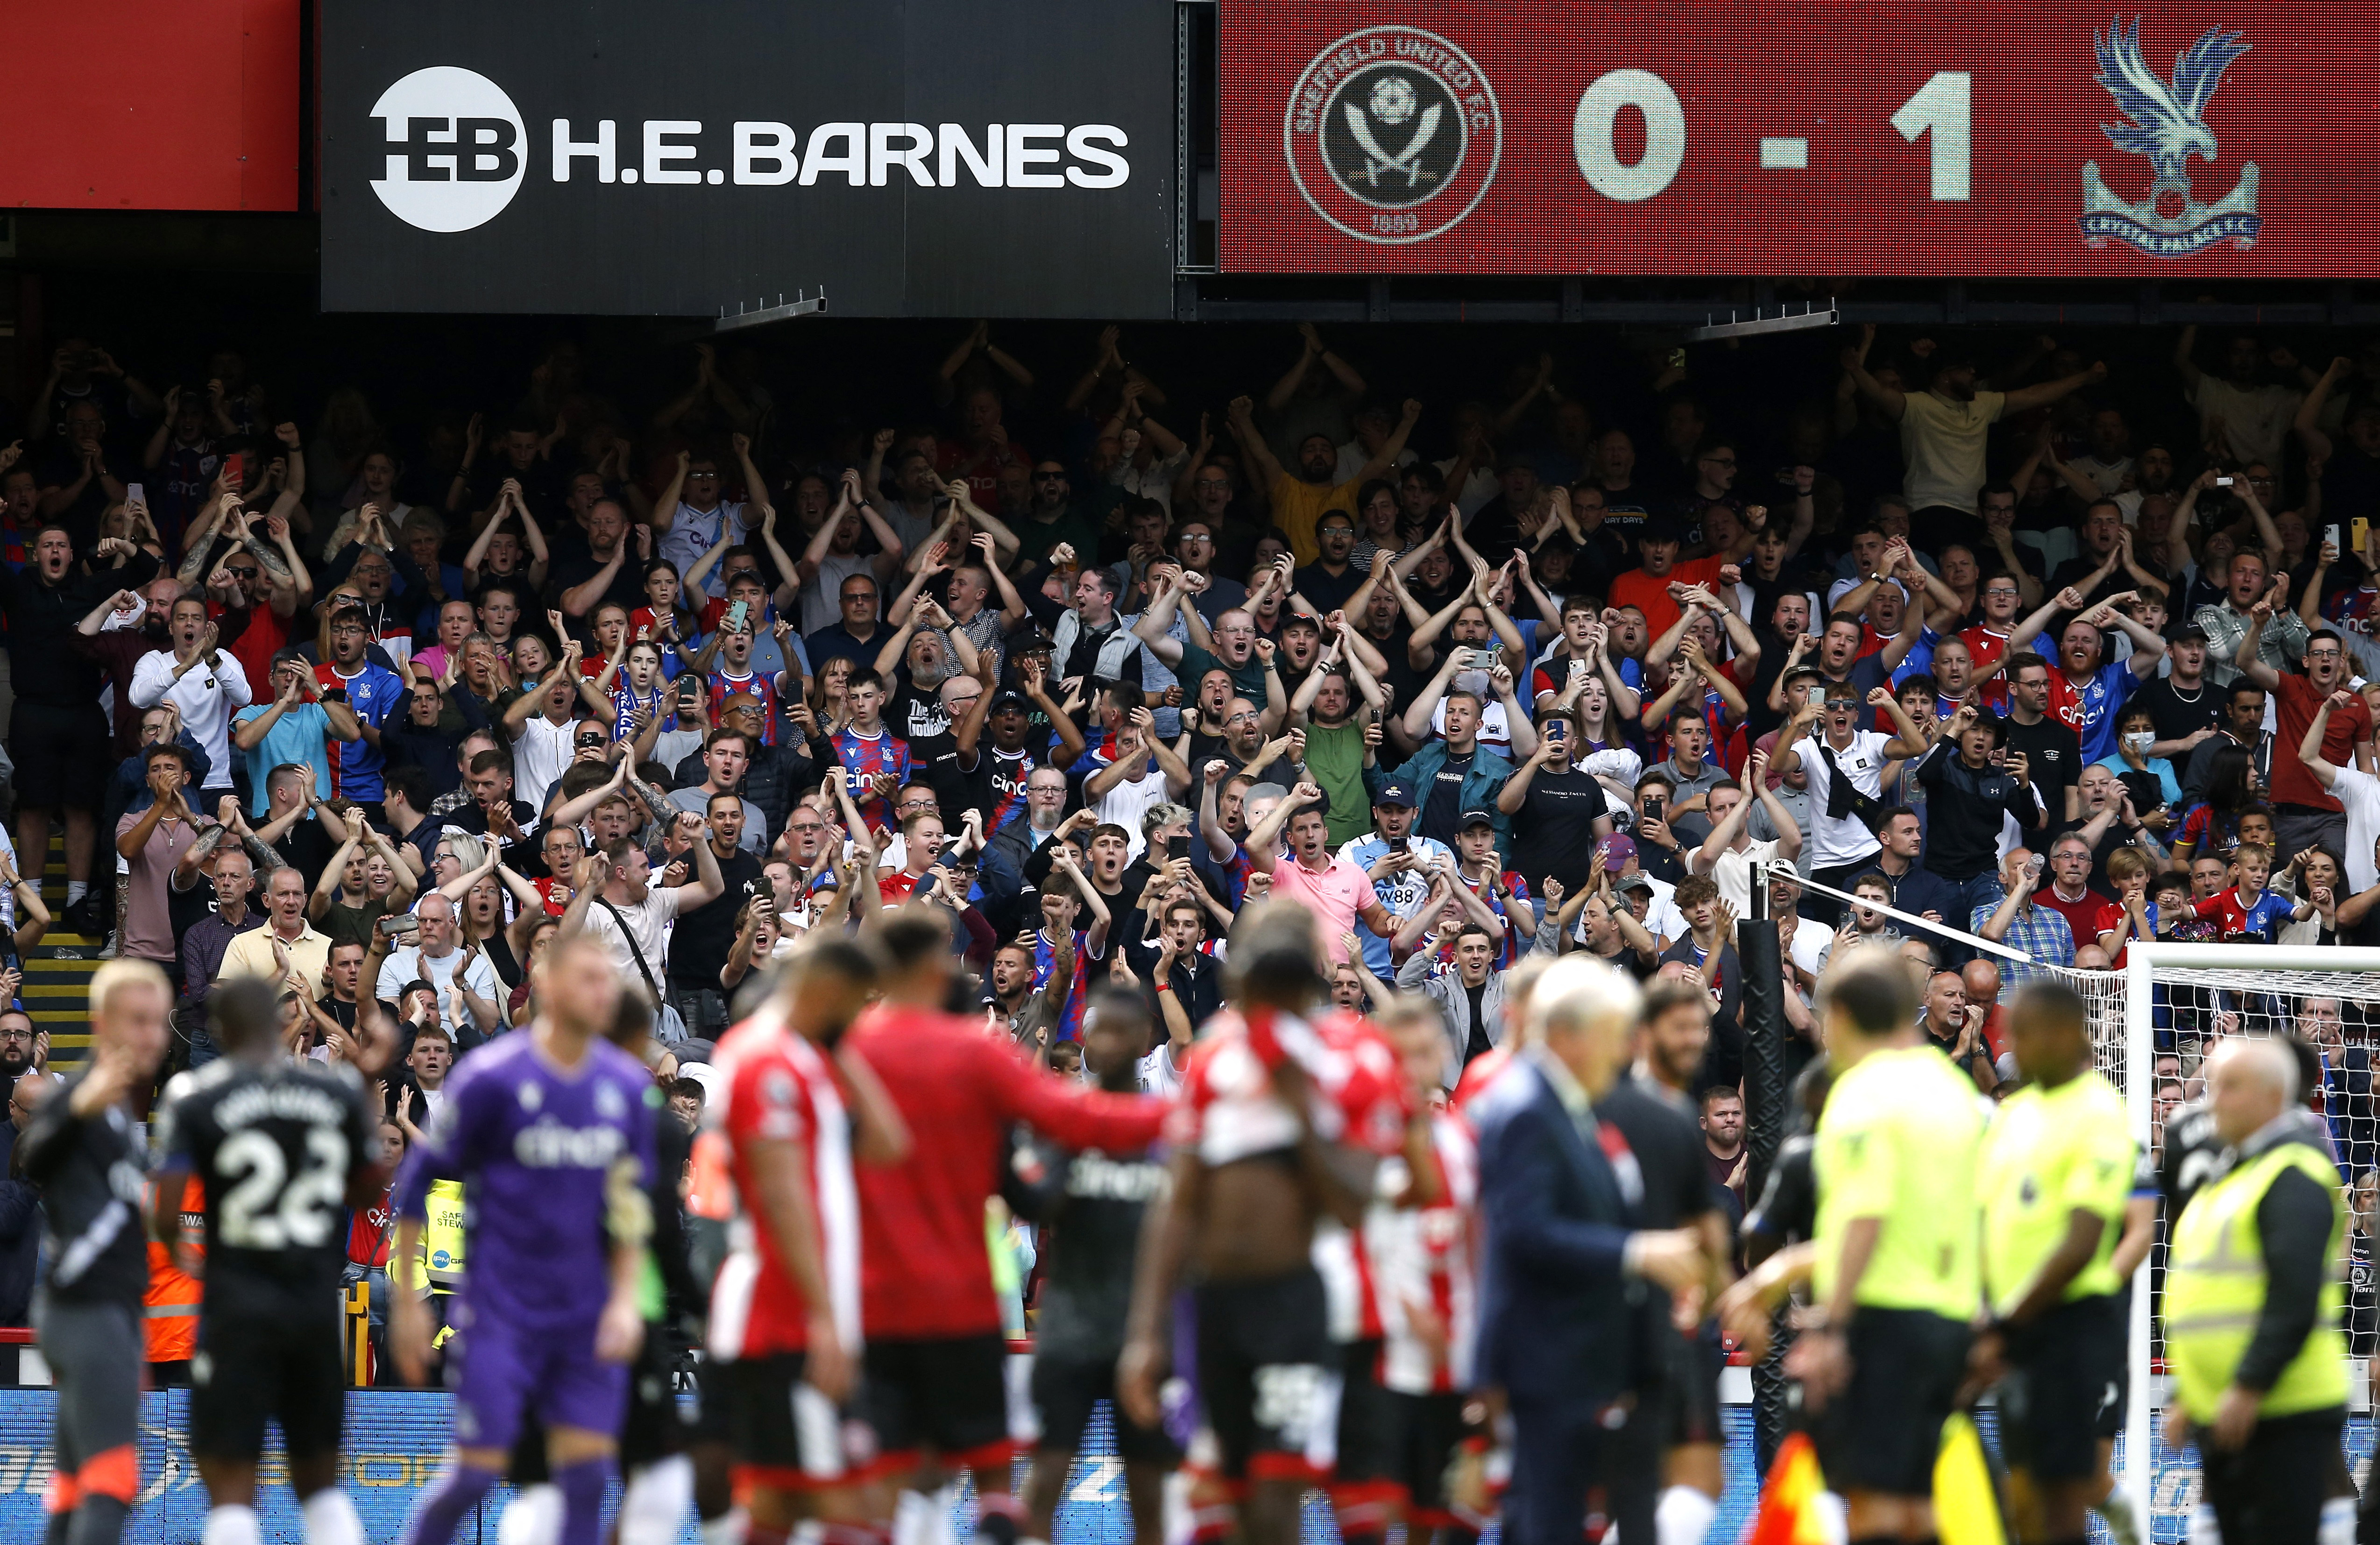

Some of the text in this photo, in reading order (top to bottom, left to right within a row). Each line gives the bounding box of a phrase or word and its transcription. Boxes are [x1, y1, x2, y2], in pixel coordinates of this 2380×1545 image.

[1296, 38, 1386, 134] SHEFFIELD
[1395, 37, 1472, 89] UNITED
[1574, 69, 1685, 201] 0
[1891, 71, 1971, 200] 1
[1371, 213, 1418, 233] 1889
[2087, 217, 2157, 251] CRYSTAL
[2162, 224, 2223, 252] PALACE
[909, 699, 929, 716] The
[992, 773, 1027, 796] cinc
[1376, 889, 1413, 904] W88
